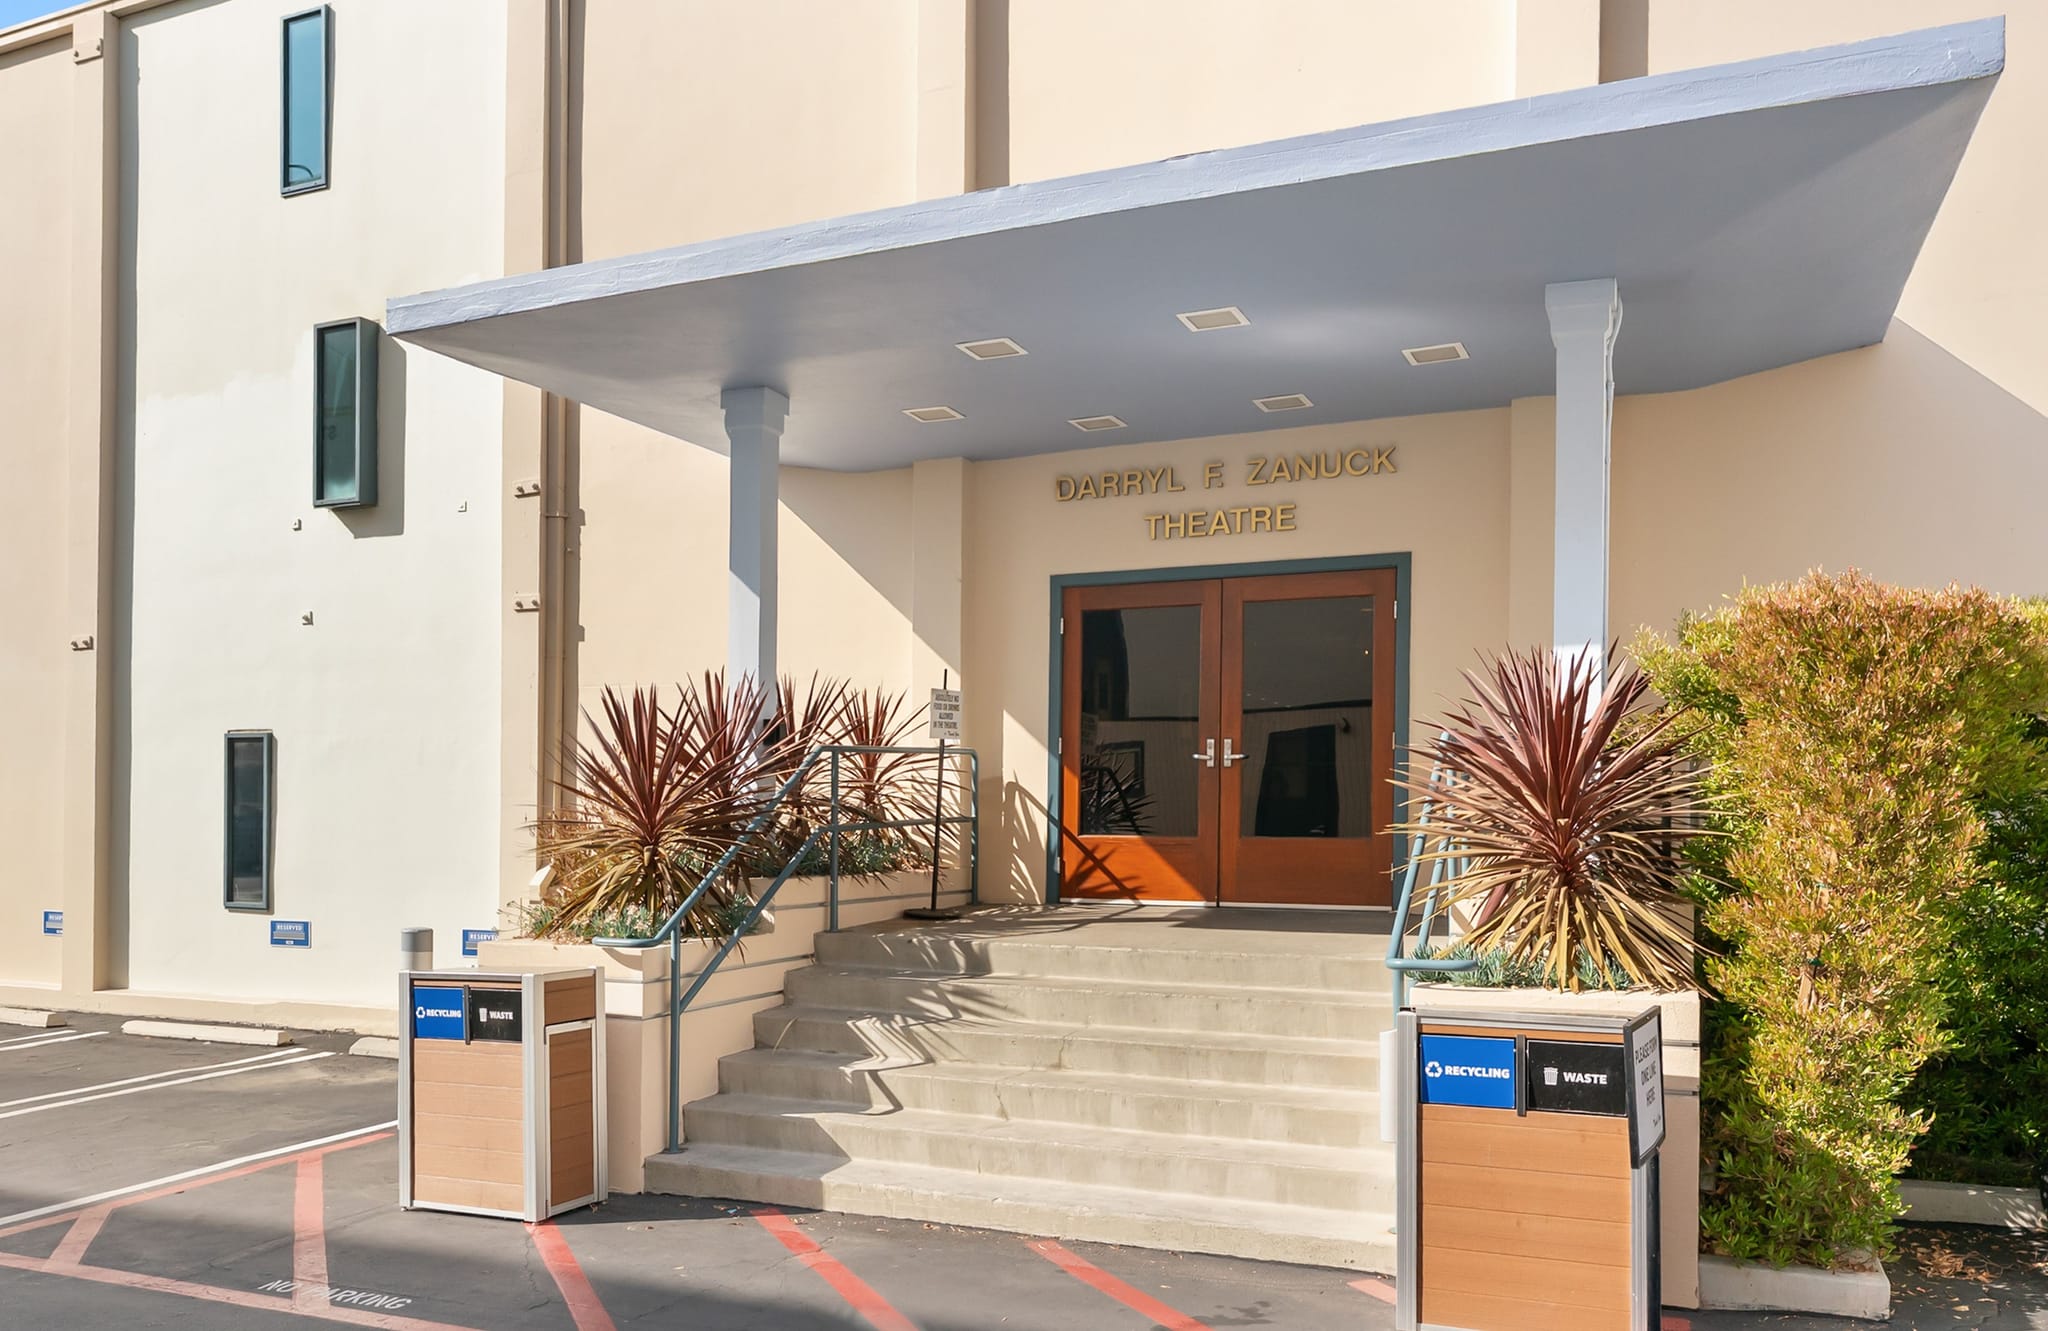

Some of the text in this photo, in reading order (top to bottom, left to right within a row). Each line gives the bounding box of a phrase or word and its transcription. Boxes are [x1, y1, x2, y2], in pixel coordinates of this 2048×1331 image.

[1056, 446, 1397, 501] DARRYL F. ZANUCK
[1144, 503, 1297, 540] THEATRE
[426, 1008, 462, 1018] RECYCLING
[489, 1010, 514, 1020] WASTE
[1635, 1043, 1650, 1064] PLEASE
[1444, 1065, 1511, 1079] RECYCLING
[1563, 1072, 1608, 1085] WASTE
[1640, 1060, 1657, 1086] ONE LINE
[1646, 1086, 1656, 1106] HERE
[257, 1279, 413, 1310] NO PARKING
